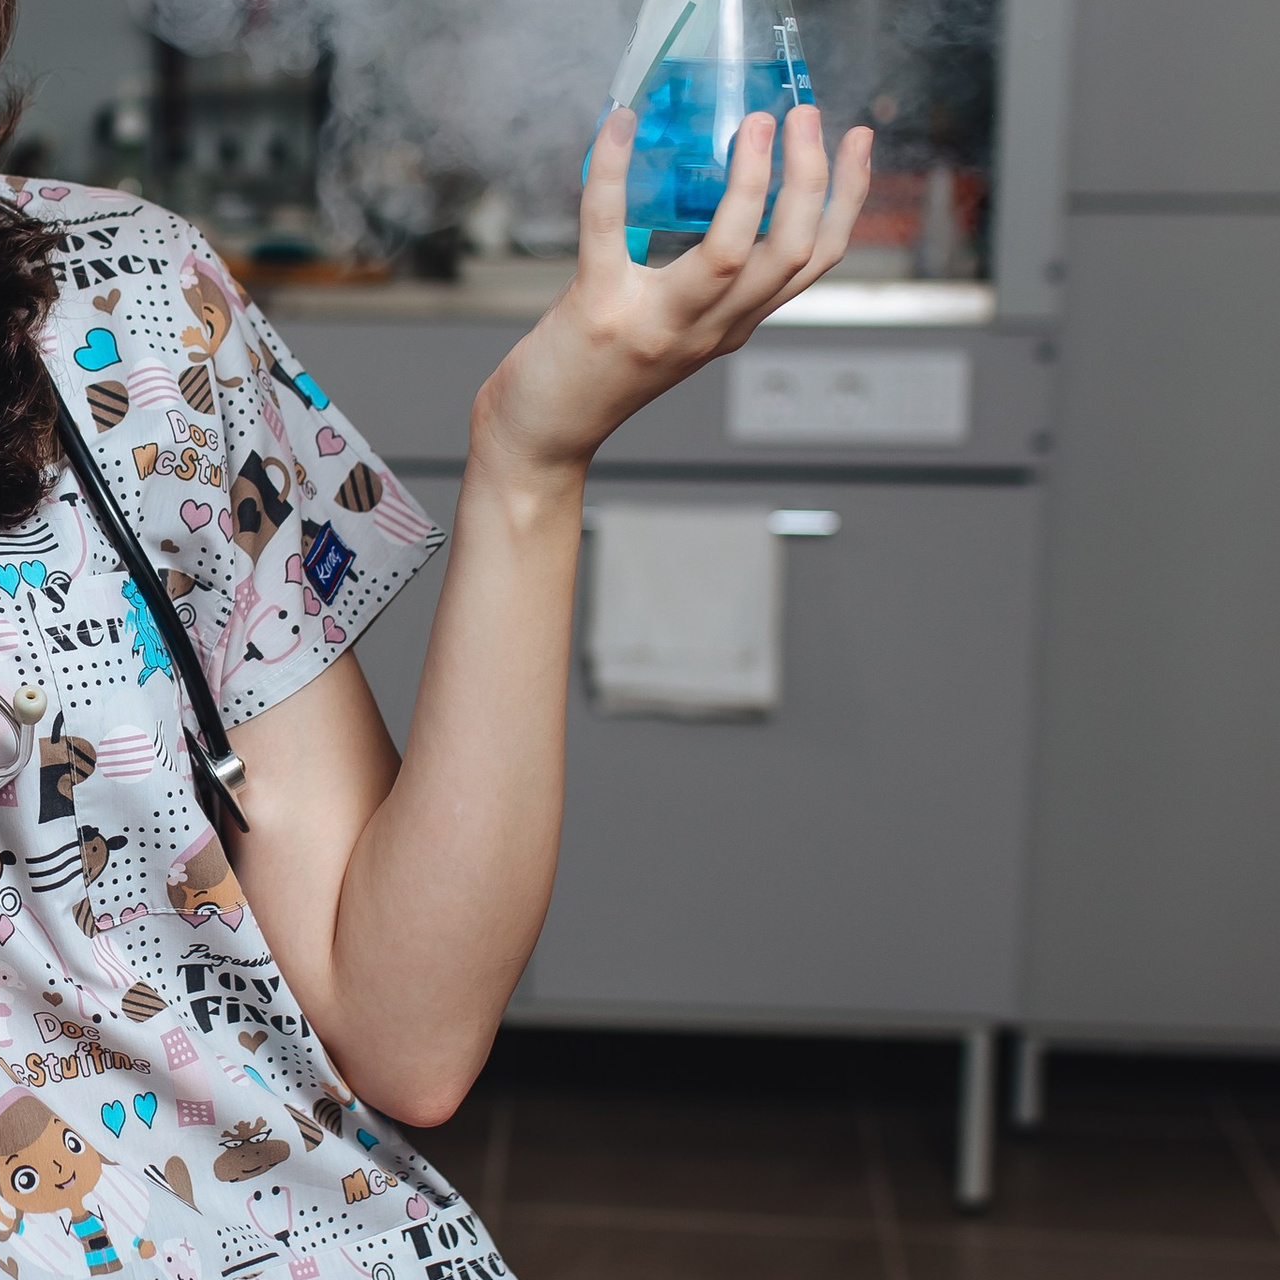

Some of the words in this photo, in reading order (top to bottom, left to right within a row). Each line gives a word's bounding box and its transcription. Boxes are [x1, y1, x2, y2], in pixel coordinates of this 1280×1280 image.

[56, 227, 120, 253] oy
[166, 410, 218, 451] Doc
[176, 964, 280, 1004] Toy
[33, 1011, 100, 1044] Doc
[401, 1214, 478, 1260] Toy
